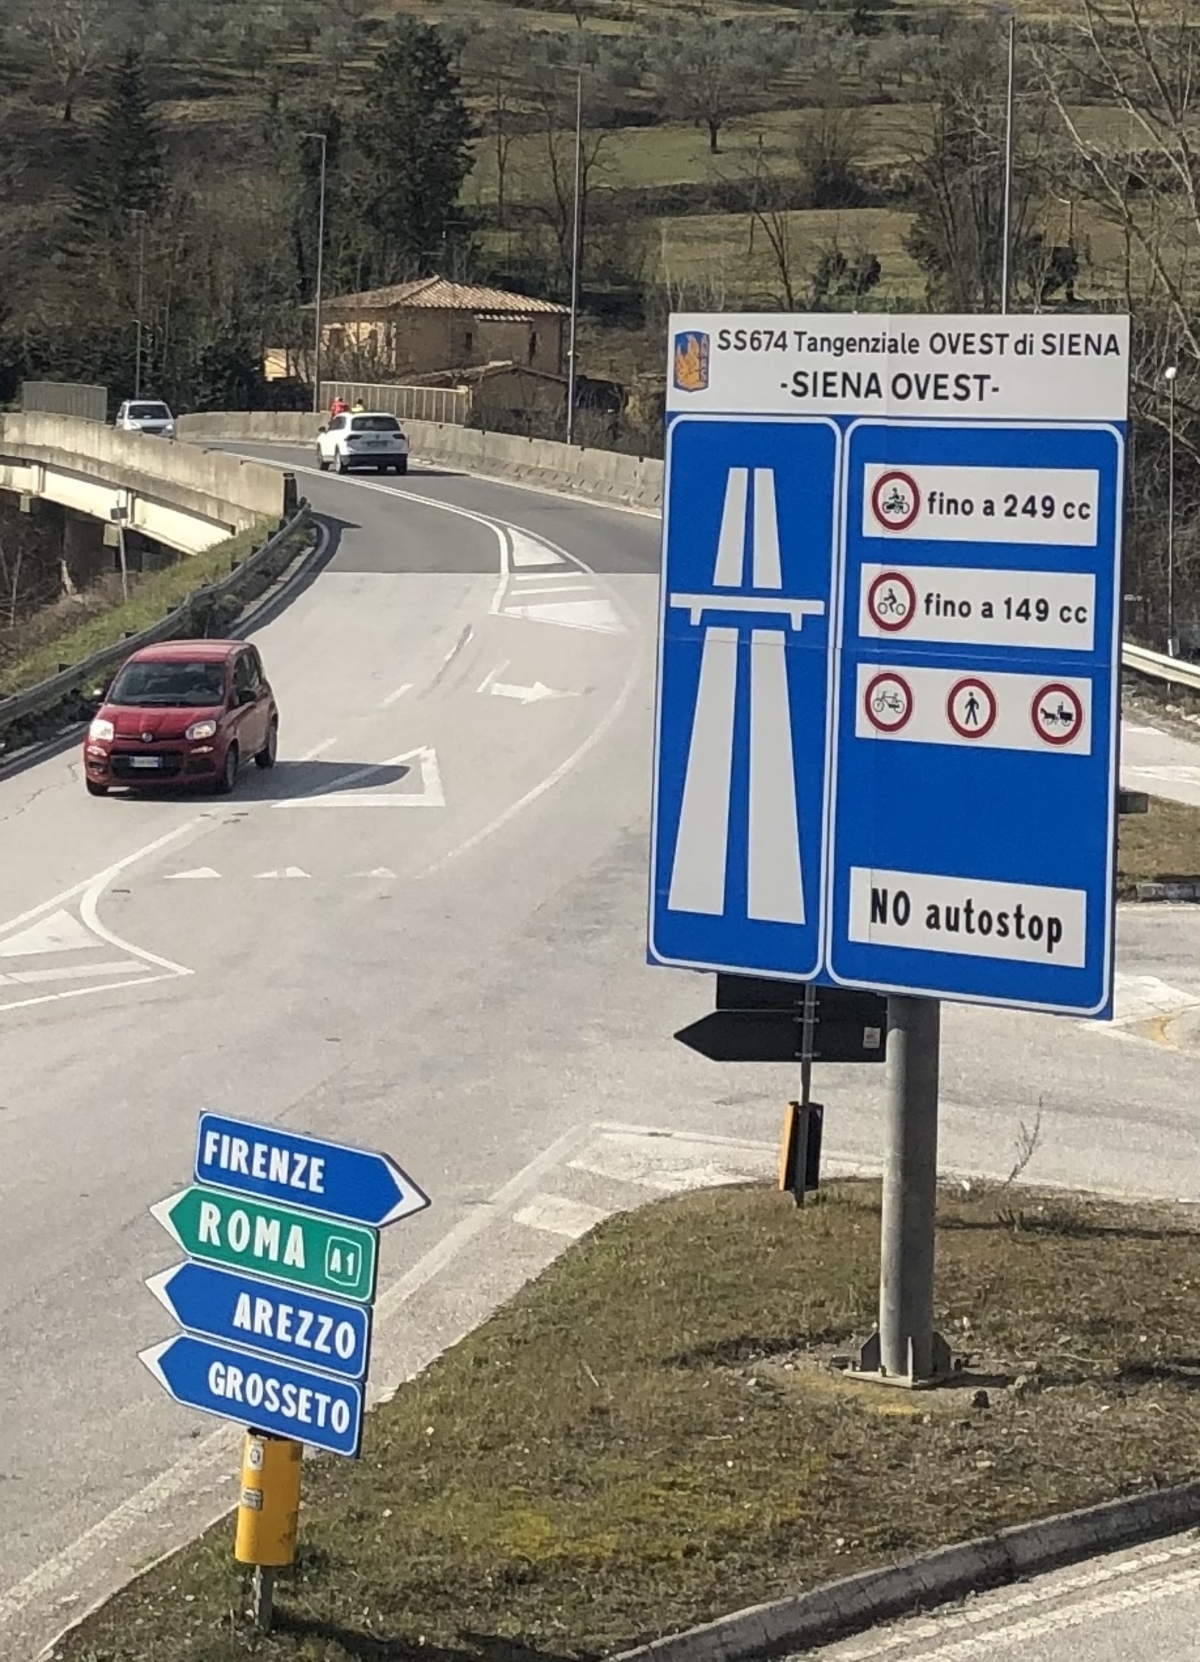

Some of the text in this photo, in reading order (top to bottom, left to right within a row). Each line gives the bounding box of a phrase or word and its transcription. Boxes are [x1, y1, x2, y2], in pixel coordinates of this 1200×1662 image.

[717, 329, 1121, 357] SS674 Tangenziale OVEST di SIENA
[780, 370, 1000, 402] -SIENA OVEST-
[927, 491, 1091, 520] fino a 249 cc
[924, 592, 1088, 624] fino a 149 cc
[870, 887, 1063, 954] NO autostop
[203, 1130, 326, 1194] FIRENZE
[197, 1200, 306, 1269] ROMA
[329, 1248, 355, 1276] A1
[232, 1292, 356, 1360] AREZZO
[208, 1361, 350, 1434] GROSSETO
